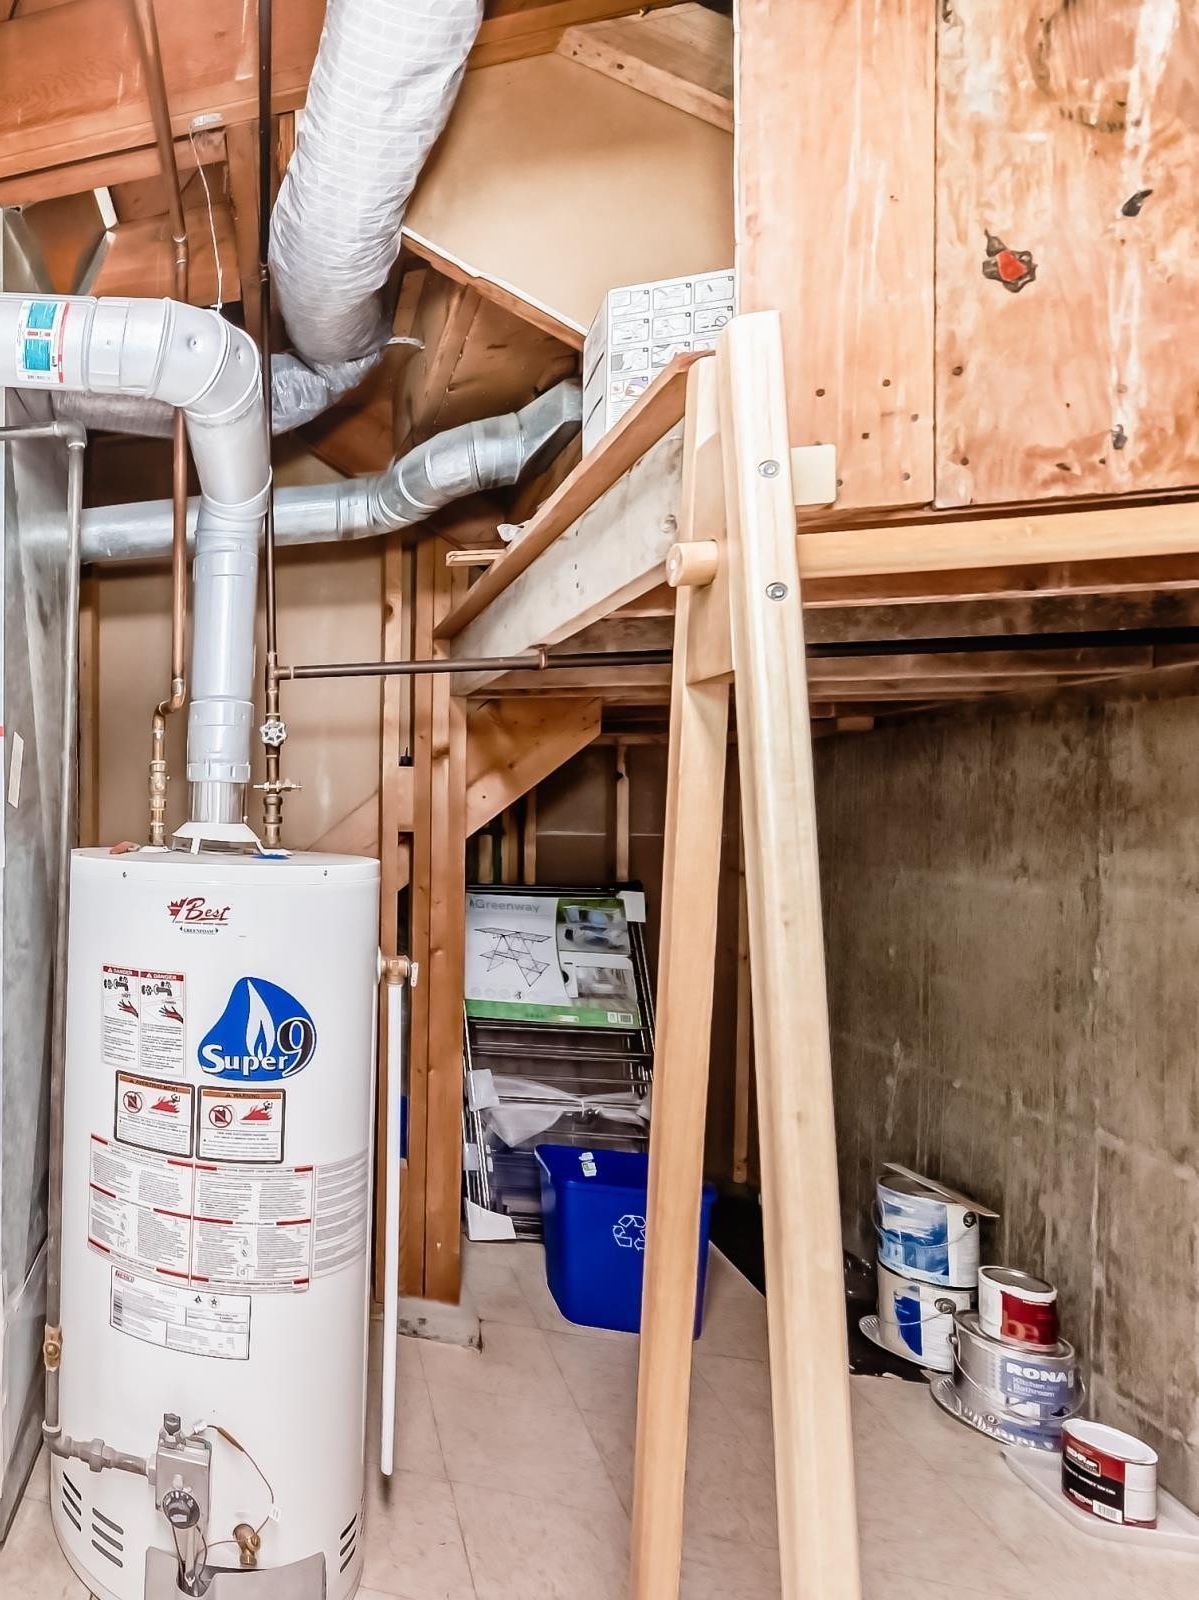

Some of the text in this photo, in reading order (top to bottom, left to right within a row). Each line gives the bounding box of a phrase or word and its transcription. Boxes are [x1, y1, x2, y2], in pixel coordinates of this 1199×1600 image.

[185, 897, 231, 921] Best
[475, 898, 540, 913] Greenway
[202, 1044, 289, 1076] Super
[277, 1017, 316, 1078] 9
[1006, 1362, 1067, 1383] RONA
